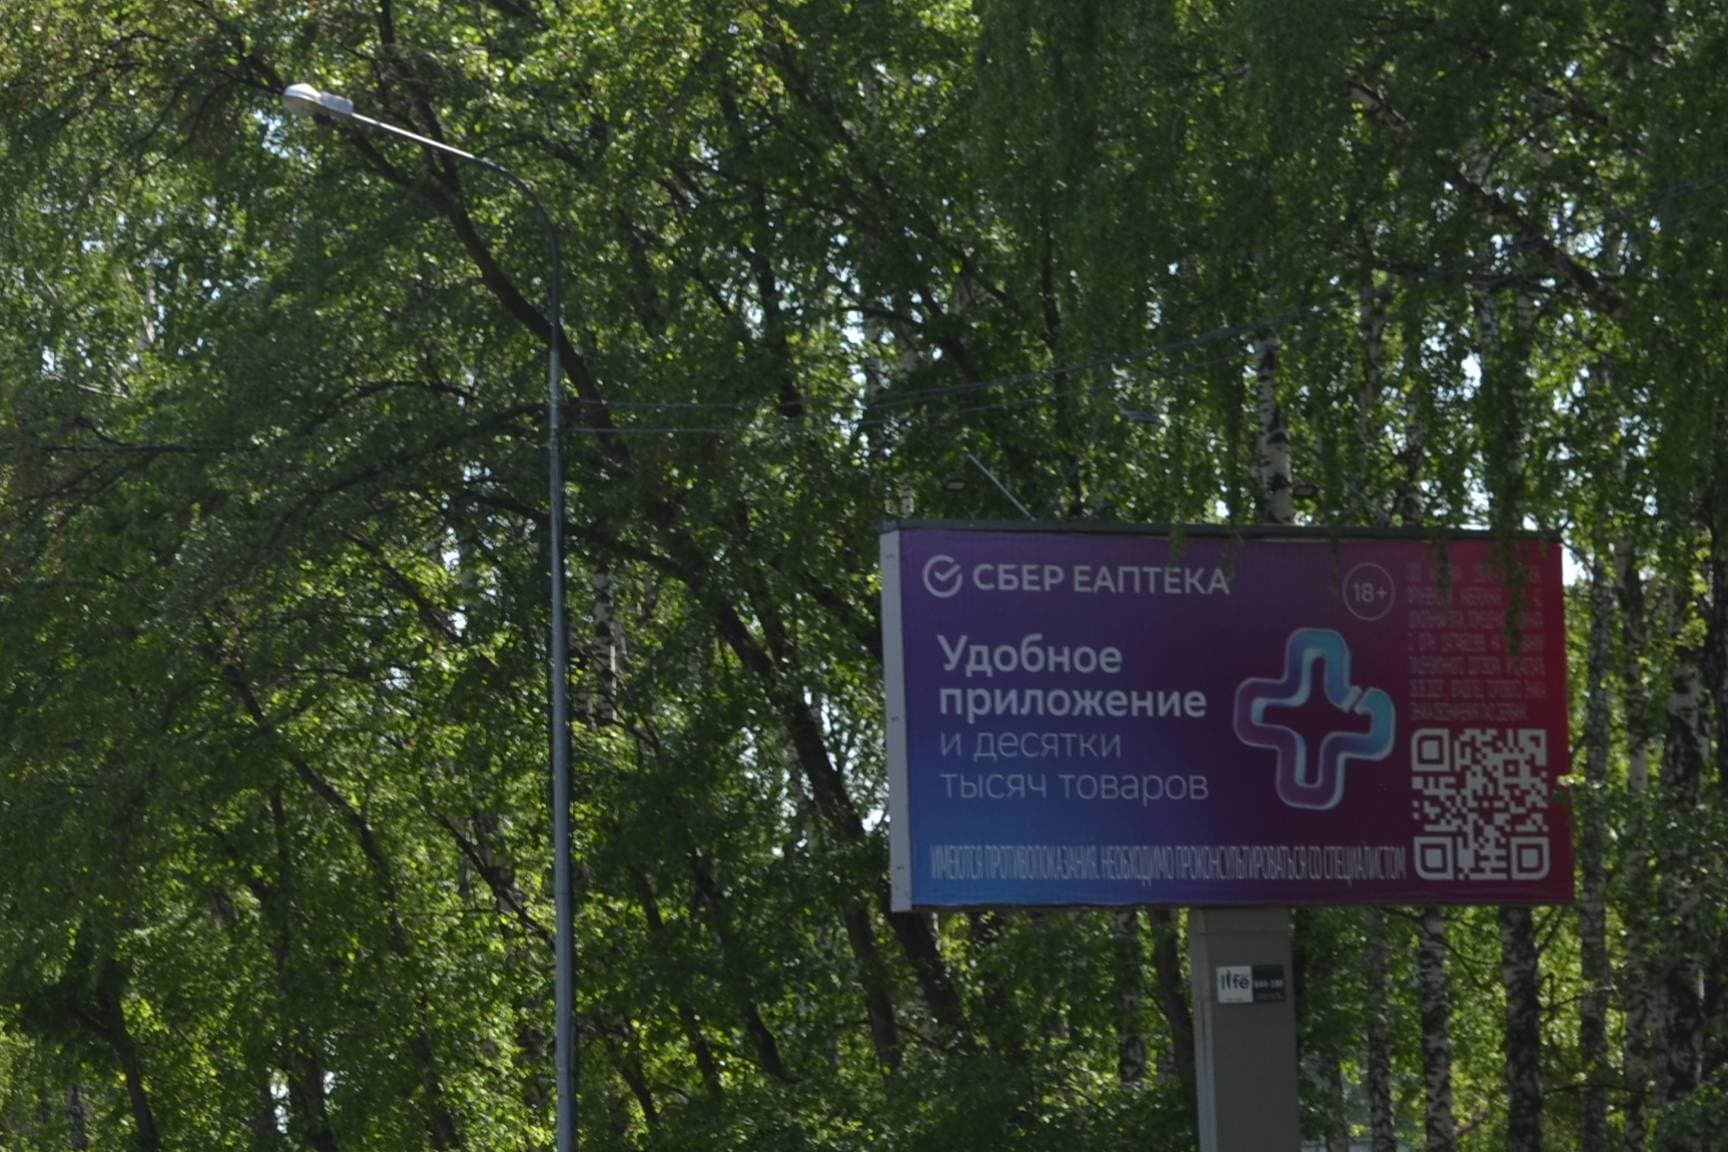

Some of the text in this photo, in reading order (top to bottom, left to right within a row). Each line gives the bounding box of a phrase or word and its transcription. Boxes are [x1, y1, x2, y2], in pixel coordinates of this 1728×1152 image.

[972, 562, 1232, 596] СБЕР ЕАПТЕКА
[1353, 582, 1388, 603] 18+
[936, 633, 1123, 678] Удобное
[938, 687, 1208, 725] приложение
[939, 731, 1122, 763] и десятки
[939, 773, 1210, 808] тысяч товаров
